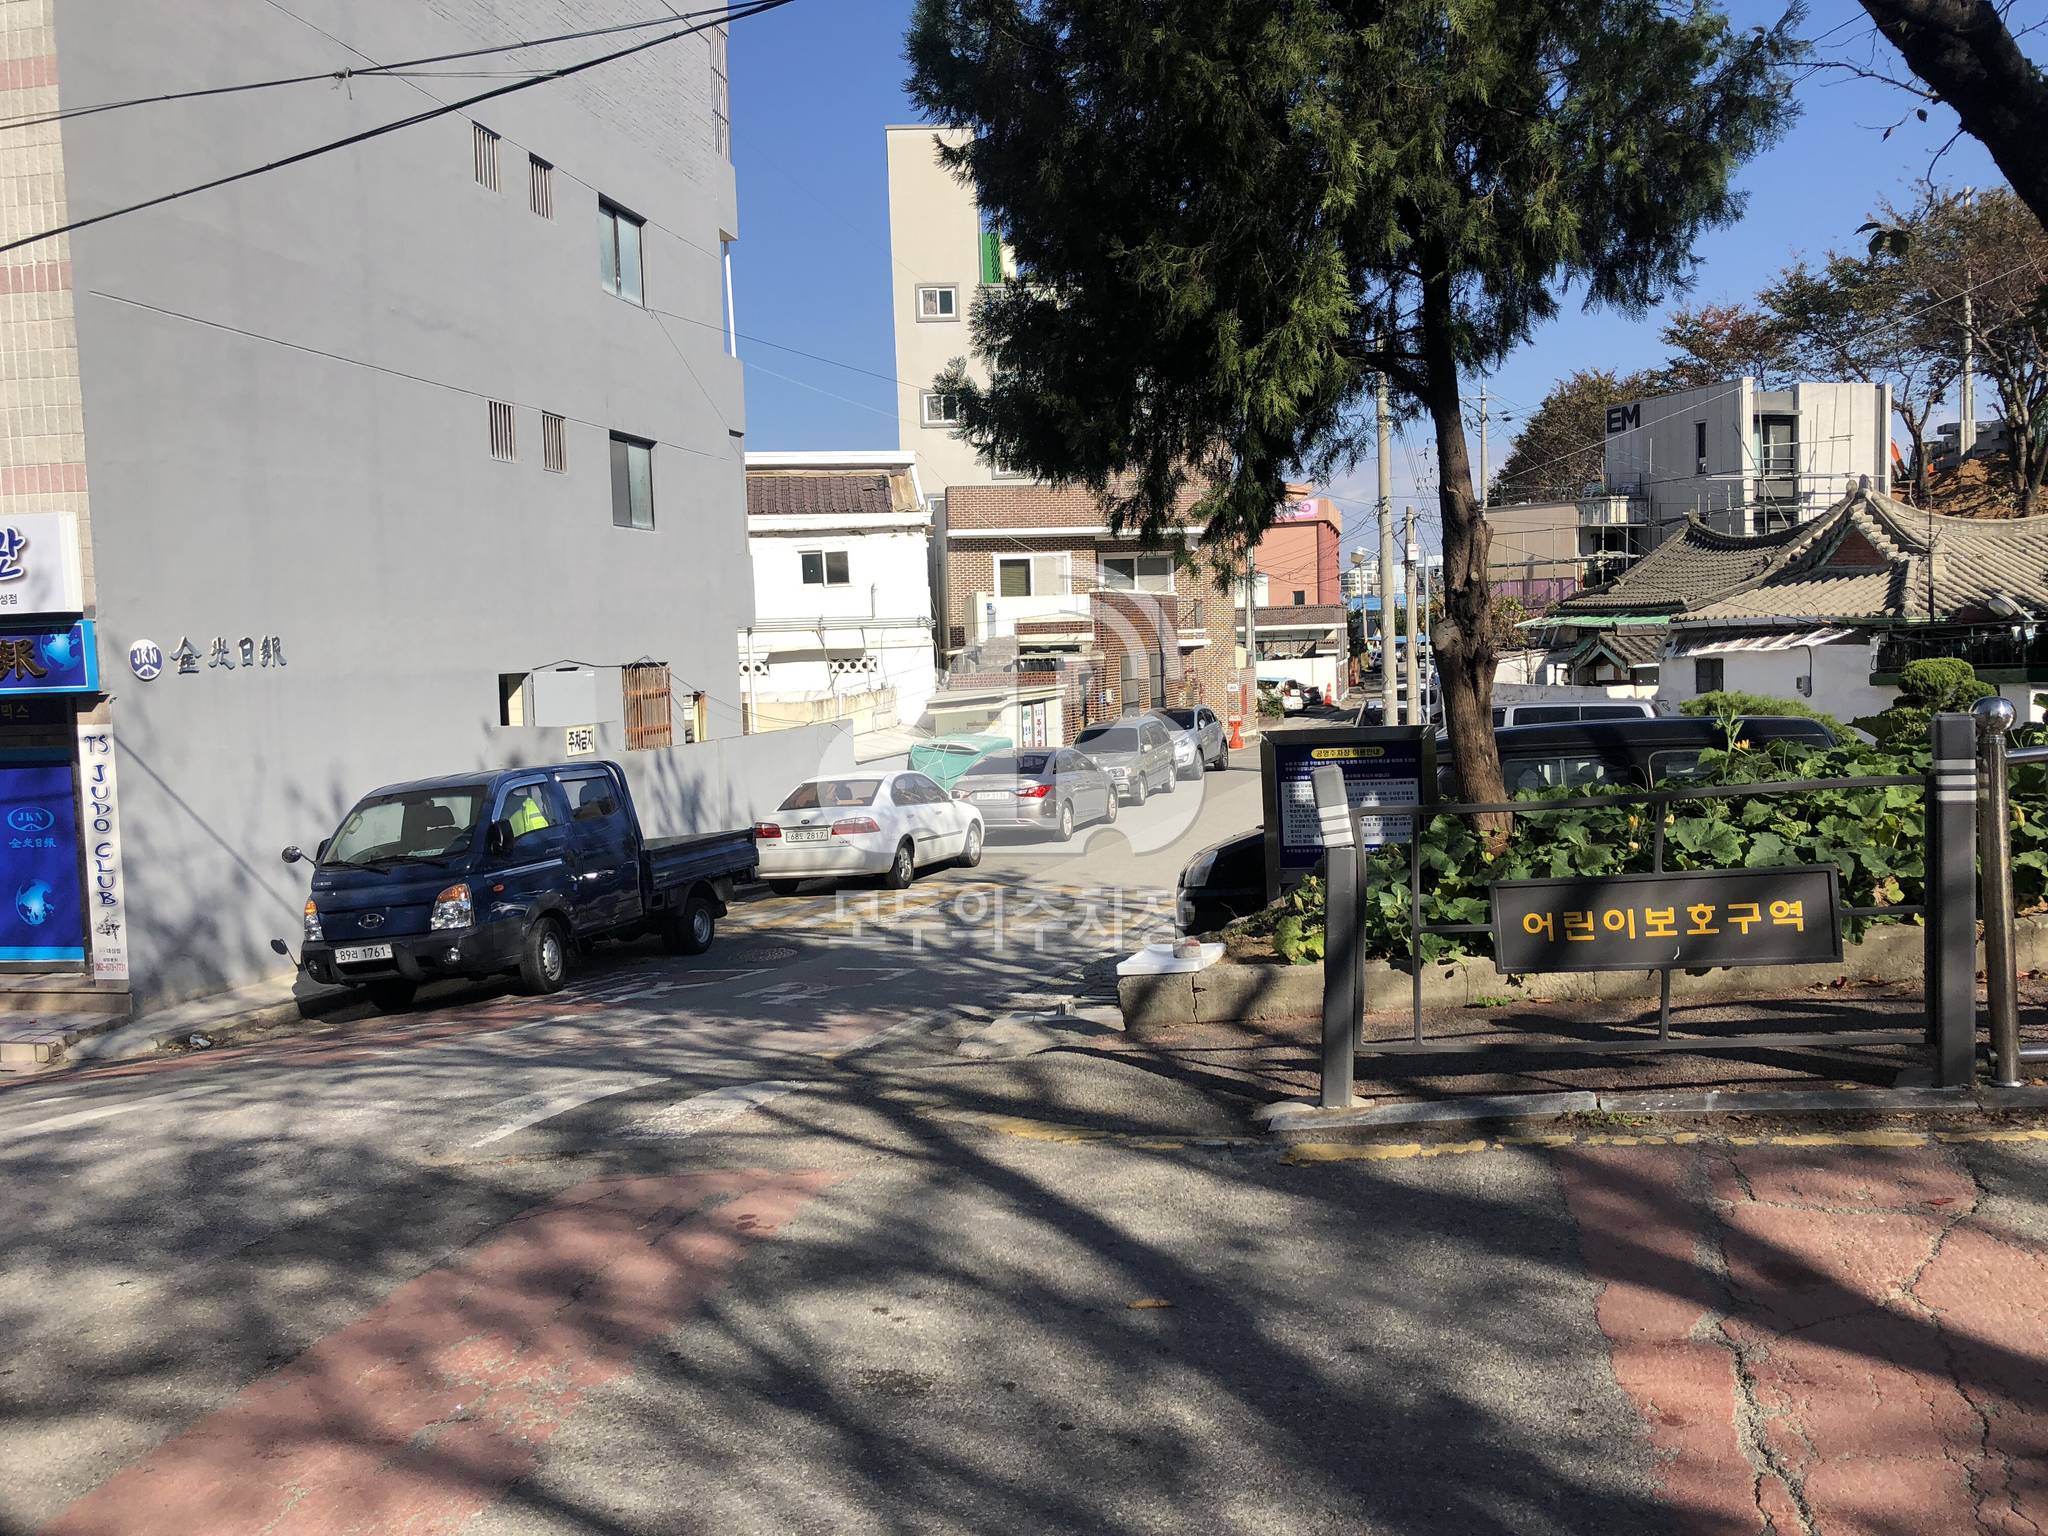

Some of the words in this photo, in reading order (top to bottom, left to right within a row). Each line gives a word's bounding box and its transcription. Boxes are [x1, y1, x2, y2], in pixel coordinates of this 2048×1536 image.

[1607, 404, 1640, 433] EM
[134, 646, 158, 665] JKN
[85, 734, 110, 753] TS
[568, 728, 594, 753] 주차금지
[91, 764, 112, 833] JUDO
[806, 831, 824, 840] 2817
[95, 842, 117, 906] CLUB
[1523, 900, 1805, 942] 어린이보호구역
[362, 946, 386, 959] 1761
